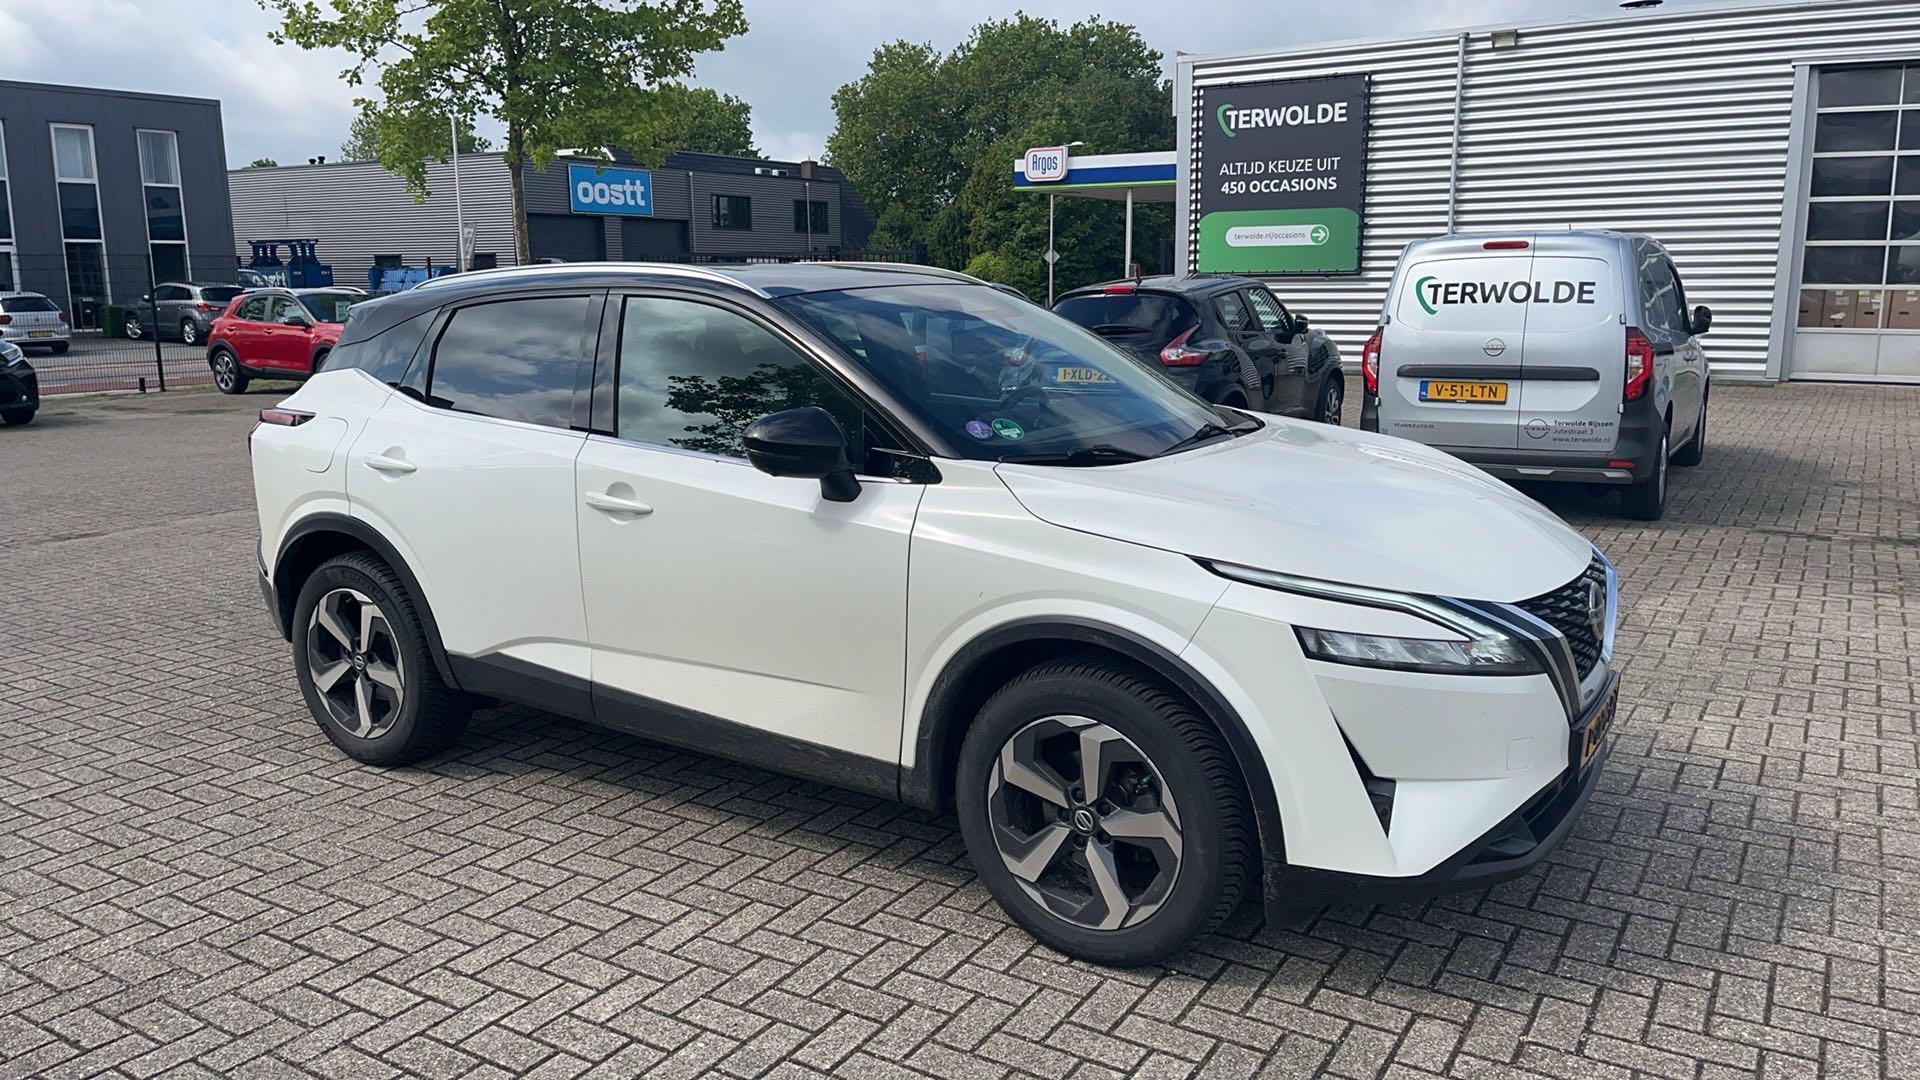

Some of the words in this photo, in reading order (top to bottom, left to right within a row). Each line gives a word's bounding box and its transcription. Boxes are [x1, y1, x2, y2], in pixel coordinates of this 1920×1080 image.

[1226, 102, 1348, 130] TERWOLDE
[1032, 154, 1058, 175] Argos
[1219, 161, 1265, 176] ALTIJD
[1268, 159, 1313, 173] KEUZE
[1317, 157, 1341, 171] UIT
[577, 179, 646, 207] oostt
[1221, 181, 1246, 194] 450
[1249, 177, 1338, 193] OCCASIONS
[1234, 232, 1306, 240] terwolde.nl/occasions
[1427, 281, 1596, 305] TERWOLDE
[1435, 383, 1498, 399] V-51-LTN
